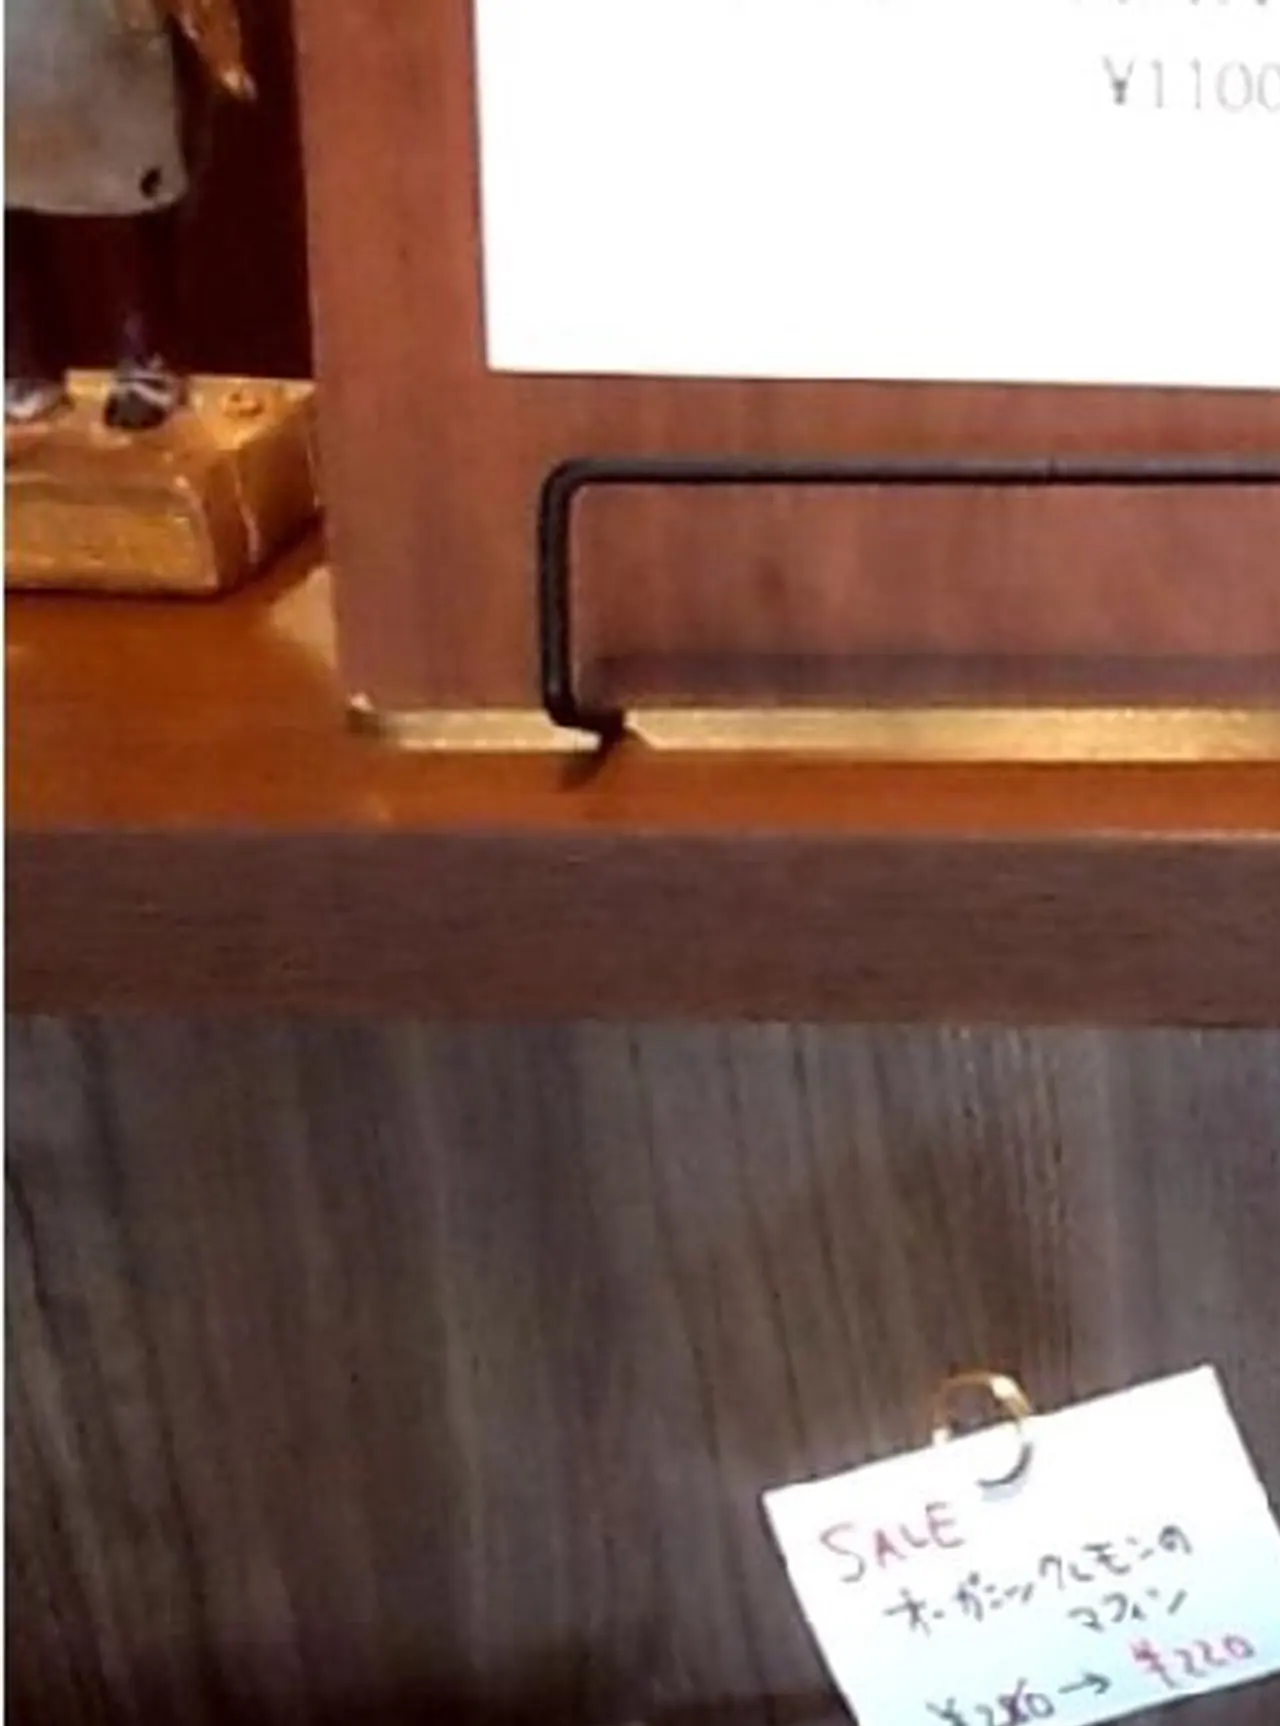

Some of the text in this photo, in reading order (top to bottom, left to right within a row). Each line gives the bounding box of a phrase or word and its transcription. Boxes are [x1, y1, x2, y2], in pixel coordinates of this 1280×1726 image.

[819, 1503, 964, 1582] SALE
[1068, 1589, 1190, 1632] マフィン
[1130, 1633, 1257, 1690] ¥220
